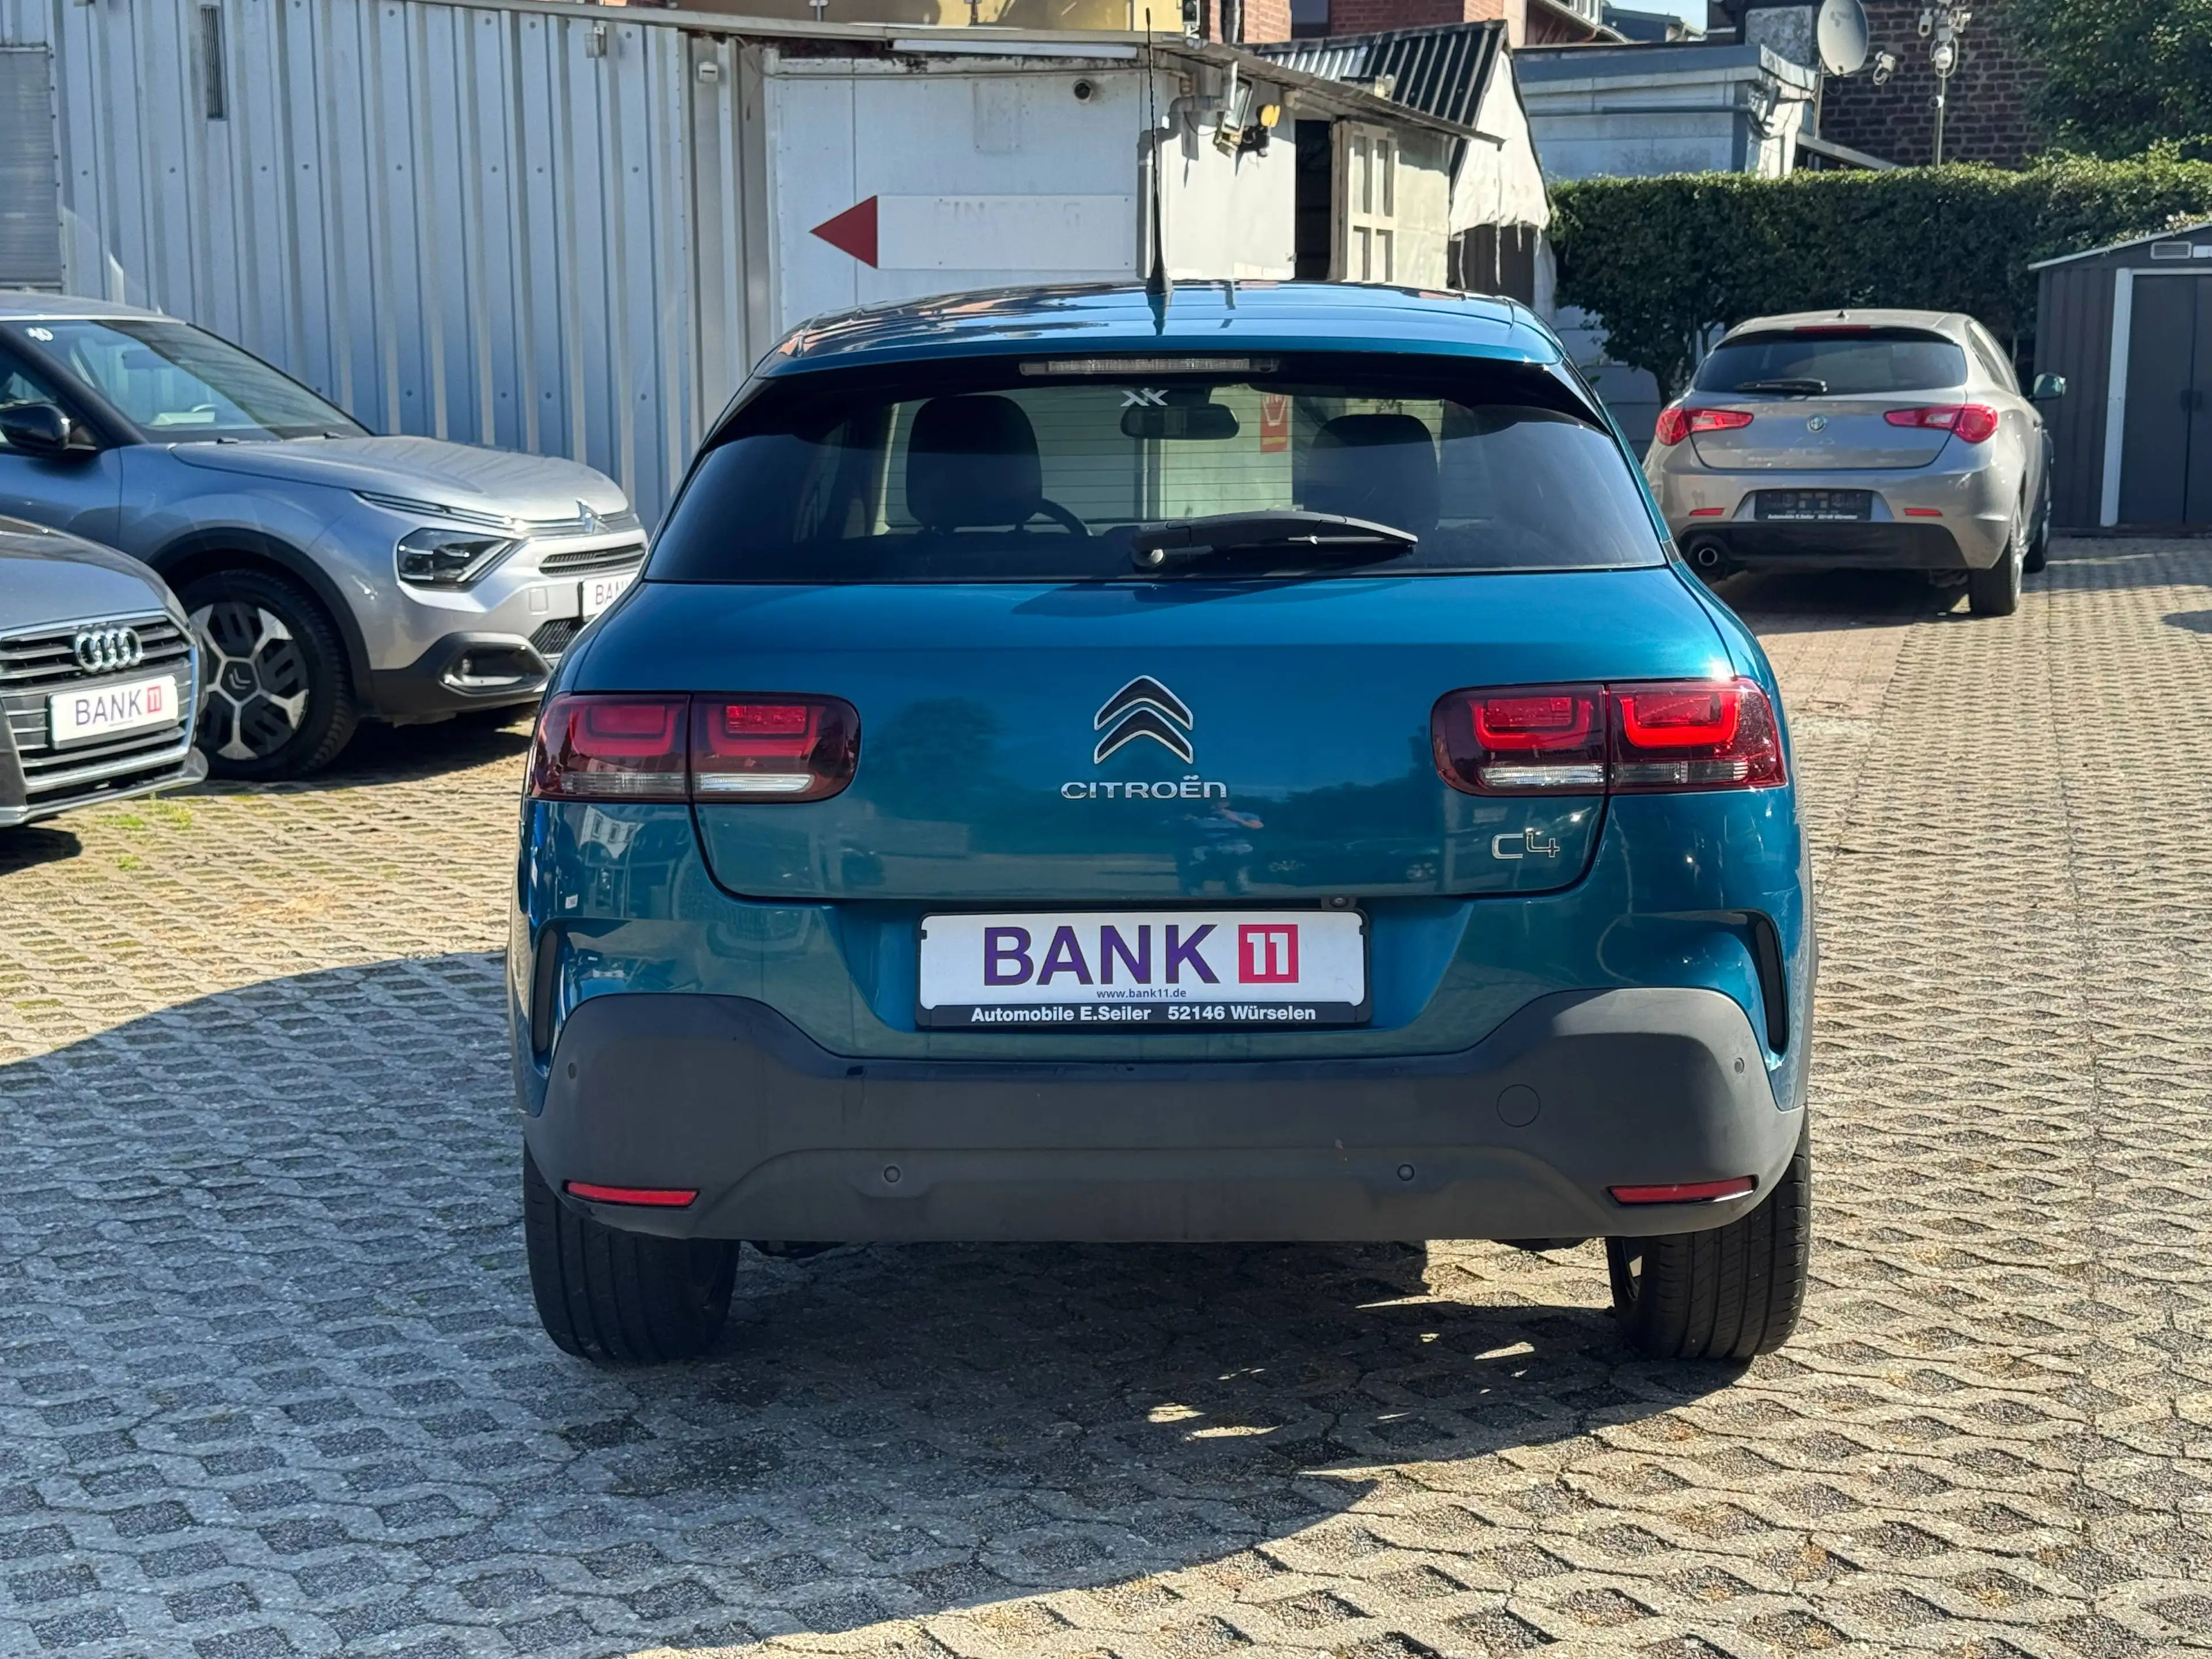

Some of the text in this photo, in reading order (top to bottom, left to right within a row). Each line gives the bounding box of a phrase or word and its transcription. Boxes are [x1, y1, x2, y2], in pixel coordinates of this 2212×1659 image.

[596, 579, 629, 605] BAN
[75, 689, 142, 726] BANK
[1060, 774, 1228, 800] CITROËN
[1491, 832, 1560, 859] C4
[983, 924, 1297, 986] BANK 11
[1096, 987, 1187, 998] www.bank11.de
[971, 1005, 1317, 1022] Automobile E.Seiler 52146 Würselen
